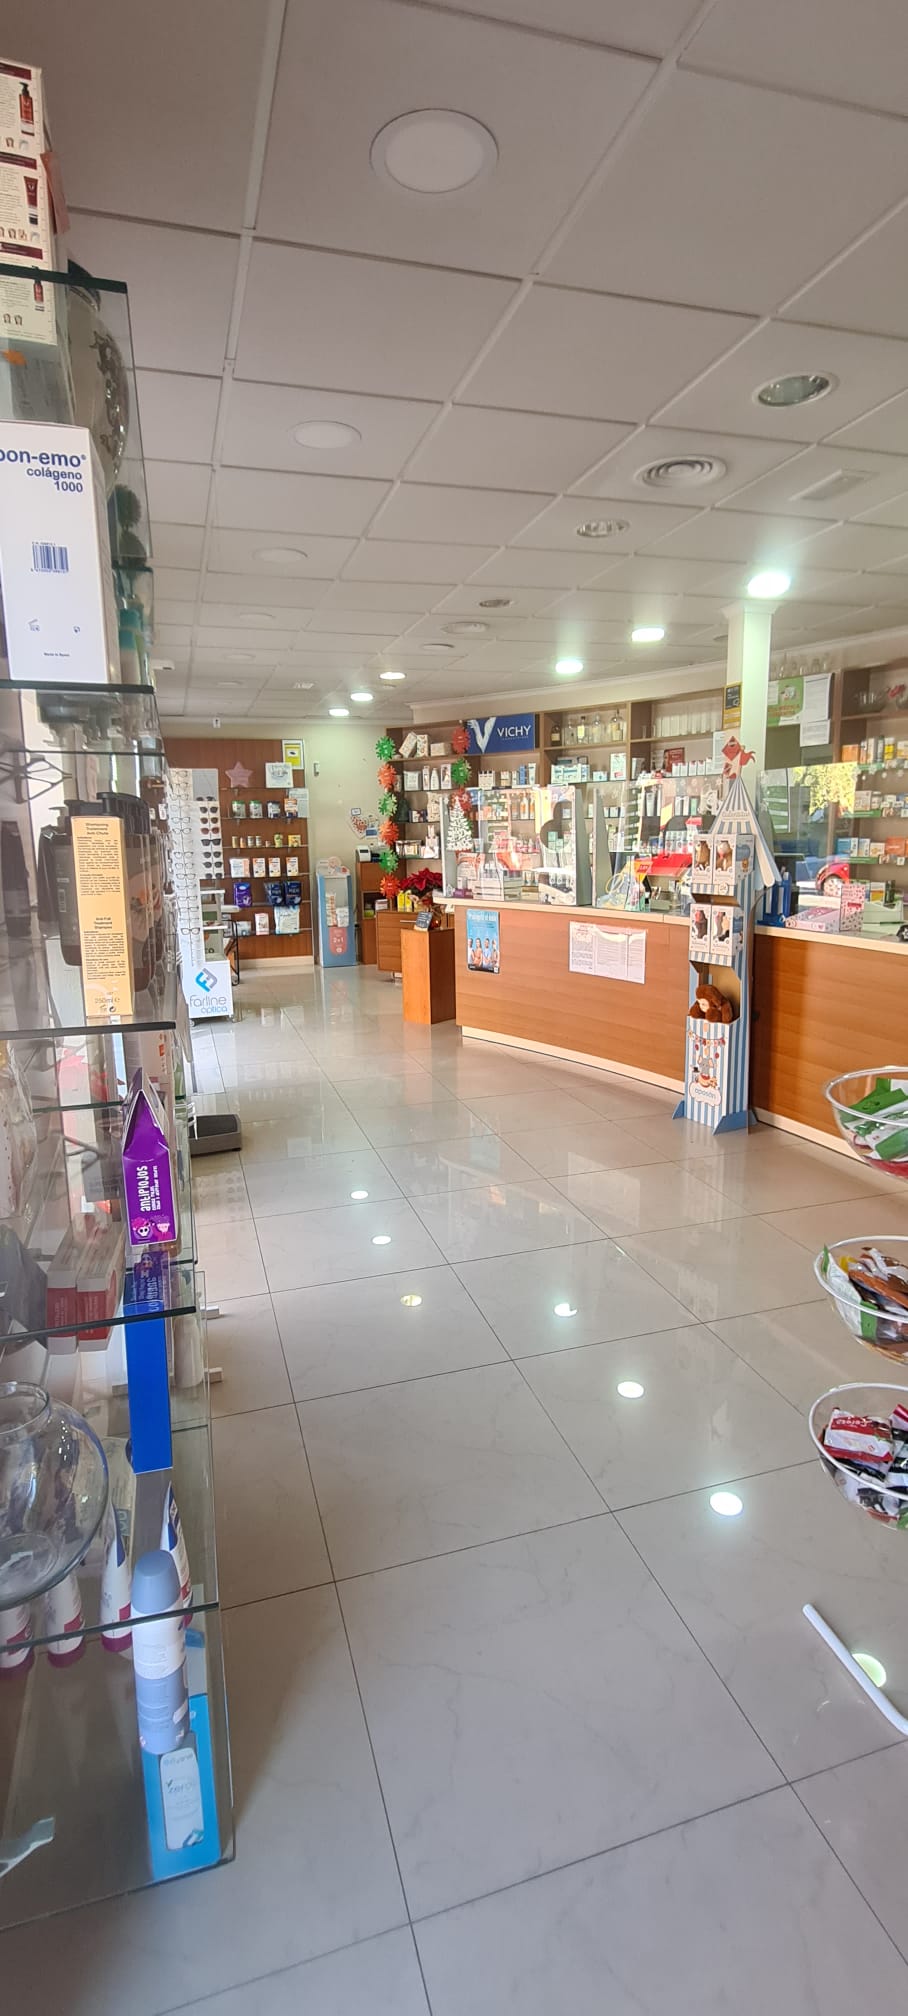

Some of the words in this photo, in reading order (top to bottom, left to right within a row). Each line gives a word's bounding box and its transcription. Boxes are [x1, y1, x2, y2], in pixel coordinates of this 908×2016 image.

[26, 466, 83, 481] colágeno
[54, 480, 84, 493] 1000
[497, 724, 532, 737] VICHY
[189, 994, 227, 1008] farline
